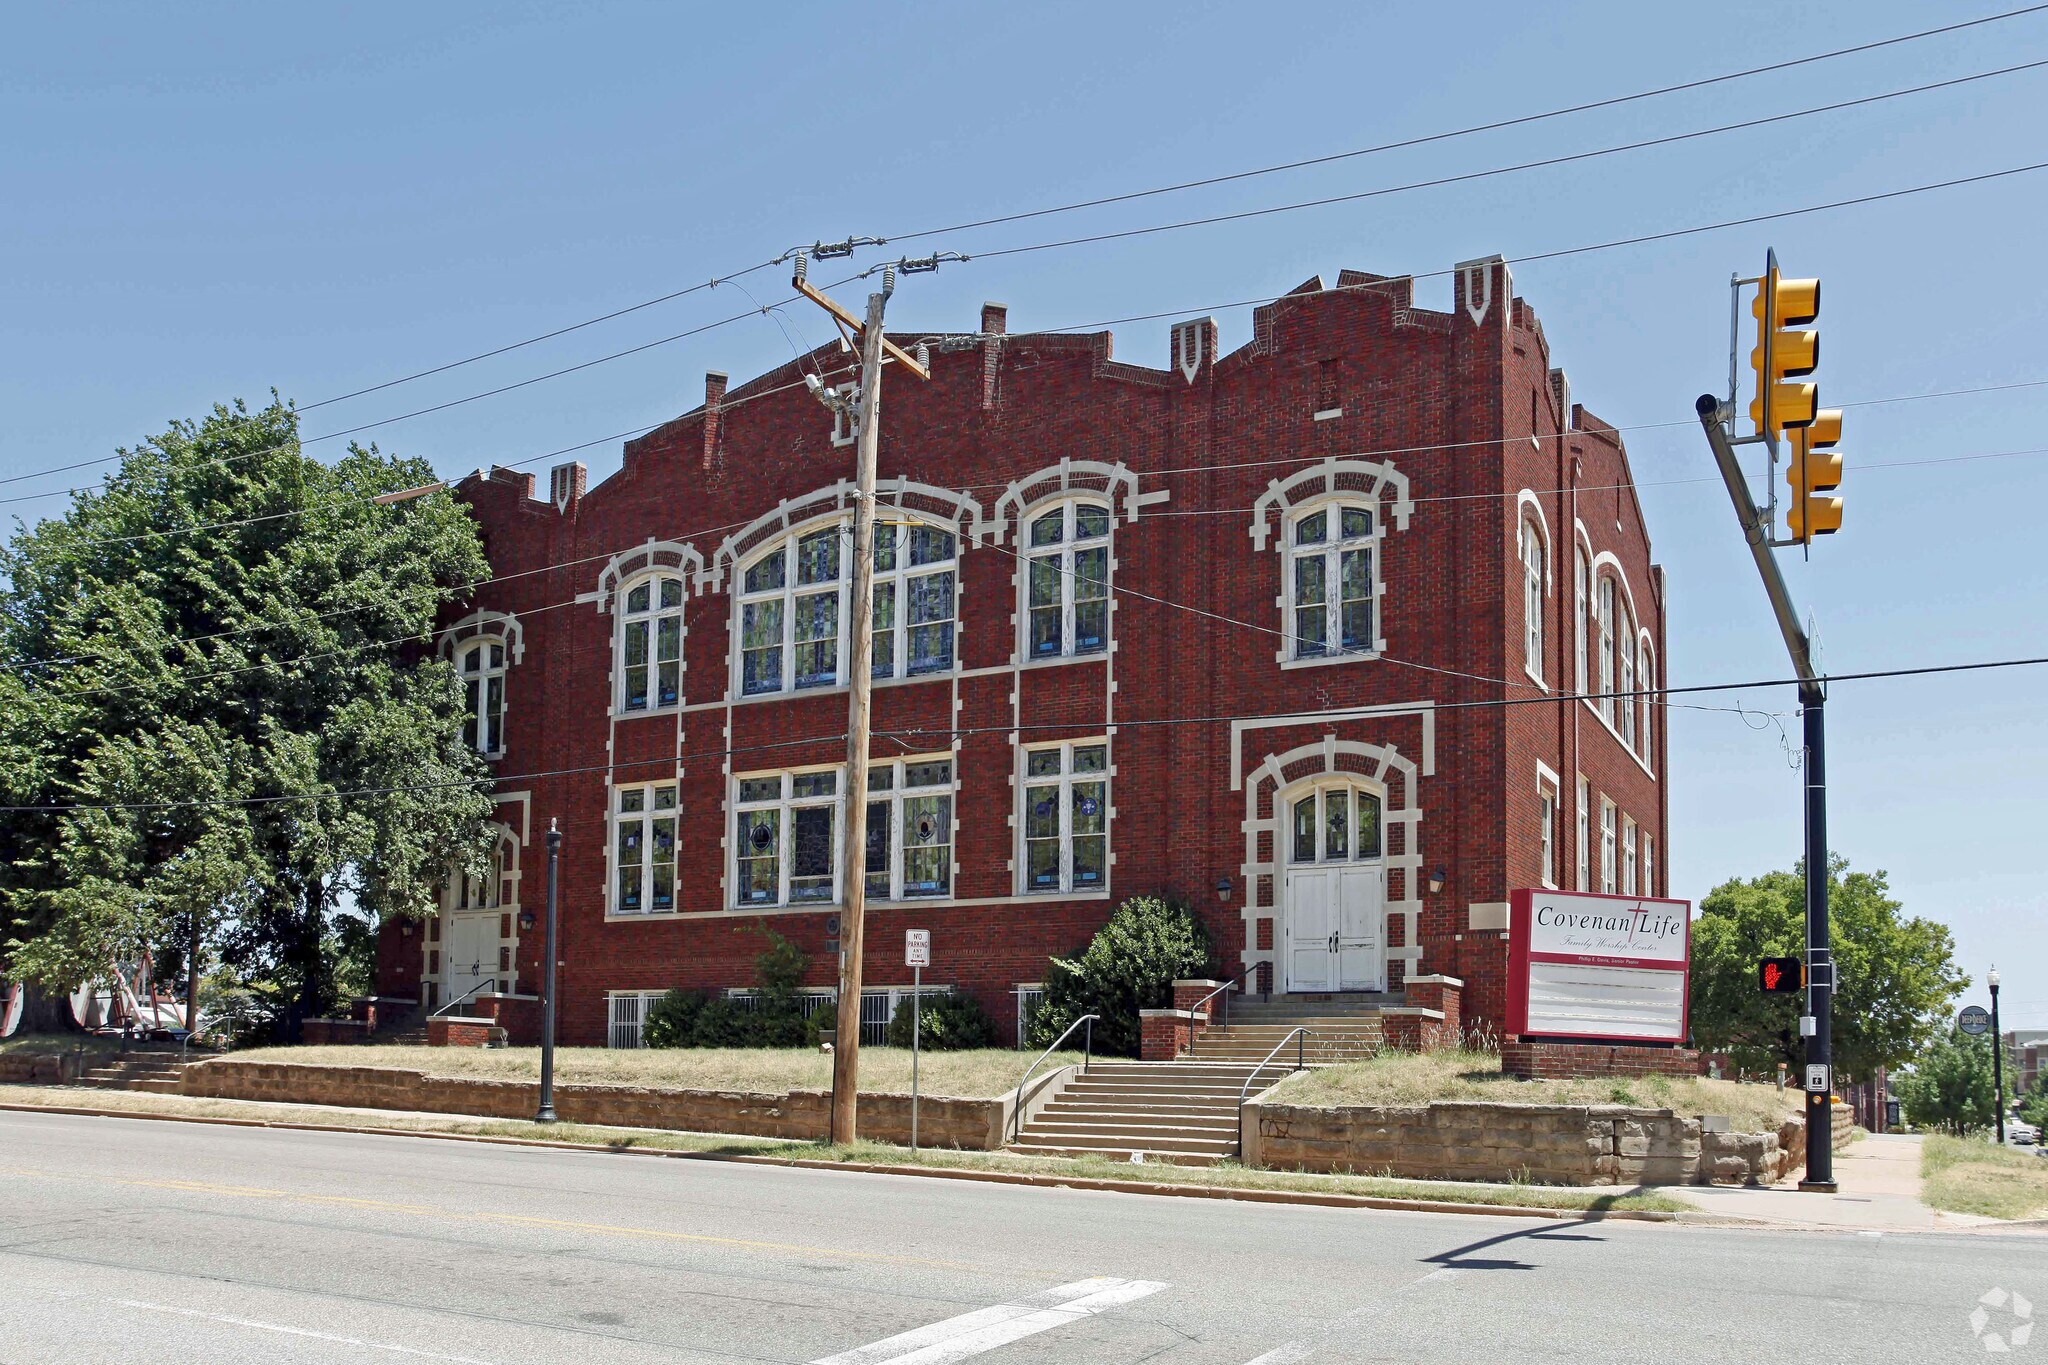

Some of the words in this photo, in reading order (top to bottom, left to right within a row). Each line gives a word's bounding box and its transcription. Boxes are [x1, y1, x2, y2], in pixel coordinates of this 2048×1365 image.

[1639, 914, 1680, 939] Life
[1560, 934, 1592, 950] Family
[1596, 937, 1629, 953] Worship
[1632, 939, 1657, 951] Center
